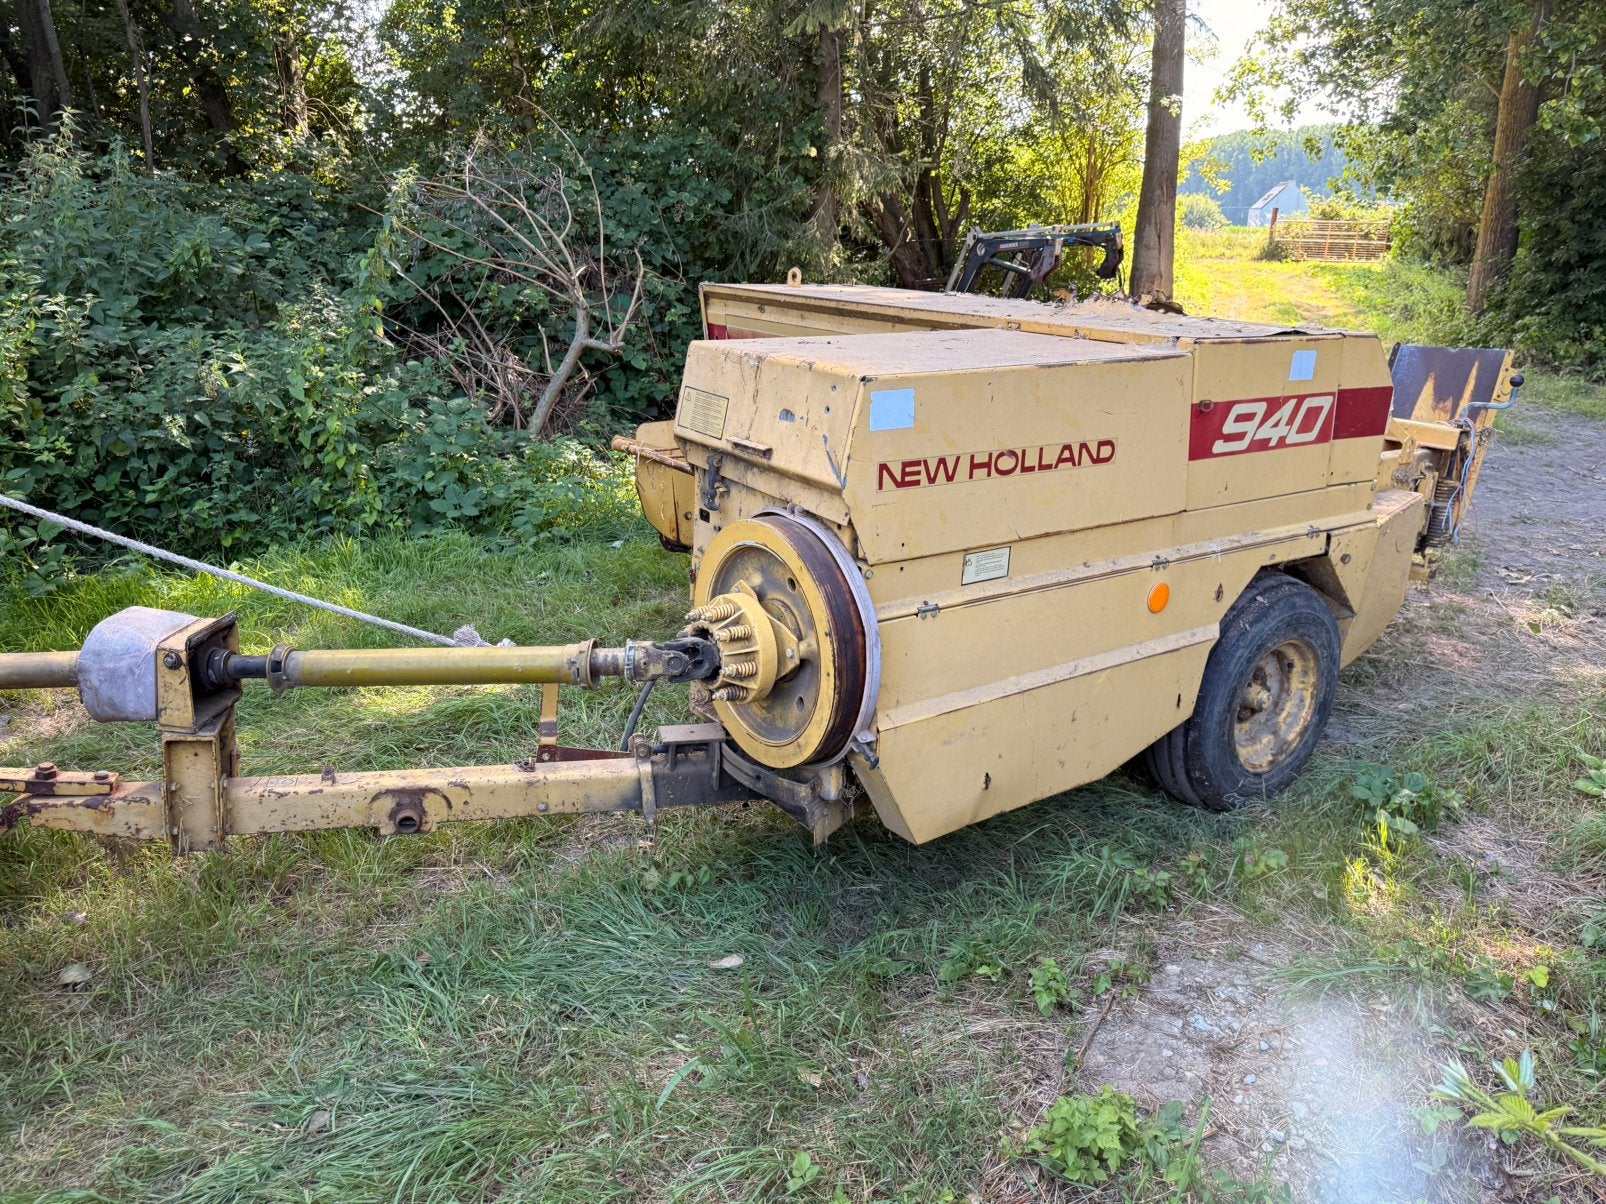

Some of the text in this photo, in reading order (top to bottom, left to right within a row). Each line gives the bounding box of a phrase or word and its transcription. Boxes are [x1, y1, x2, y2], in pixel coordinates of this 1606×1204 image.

[1212, 395, 1334, 454] 940
[878, 439, 1116, 490] NEW HOLLAND
